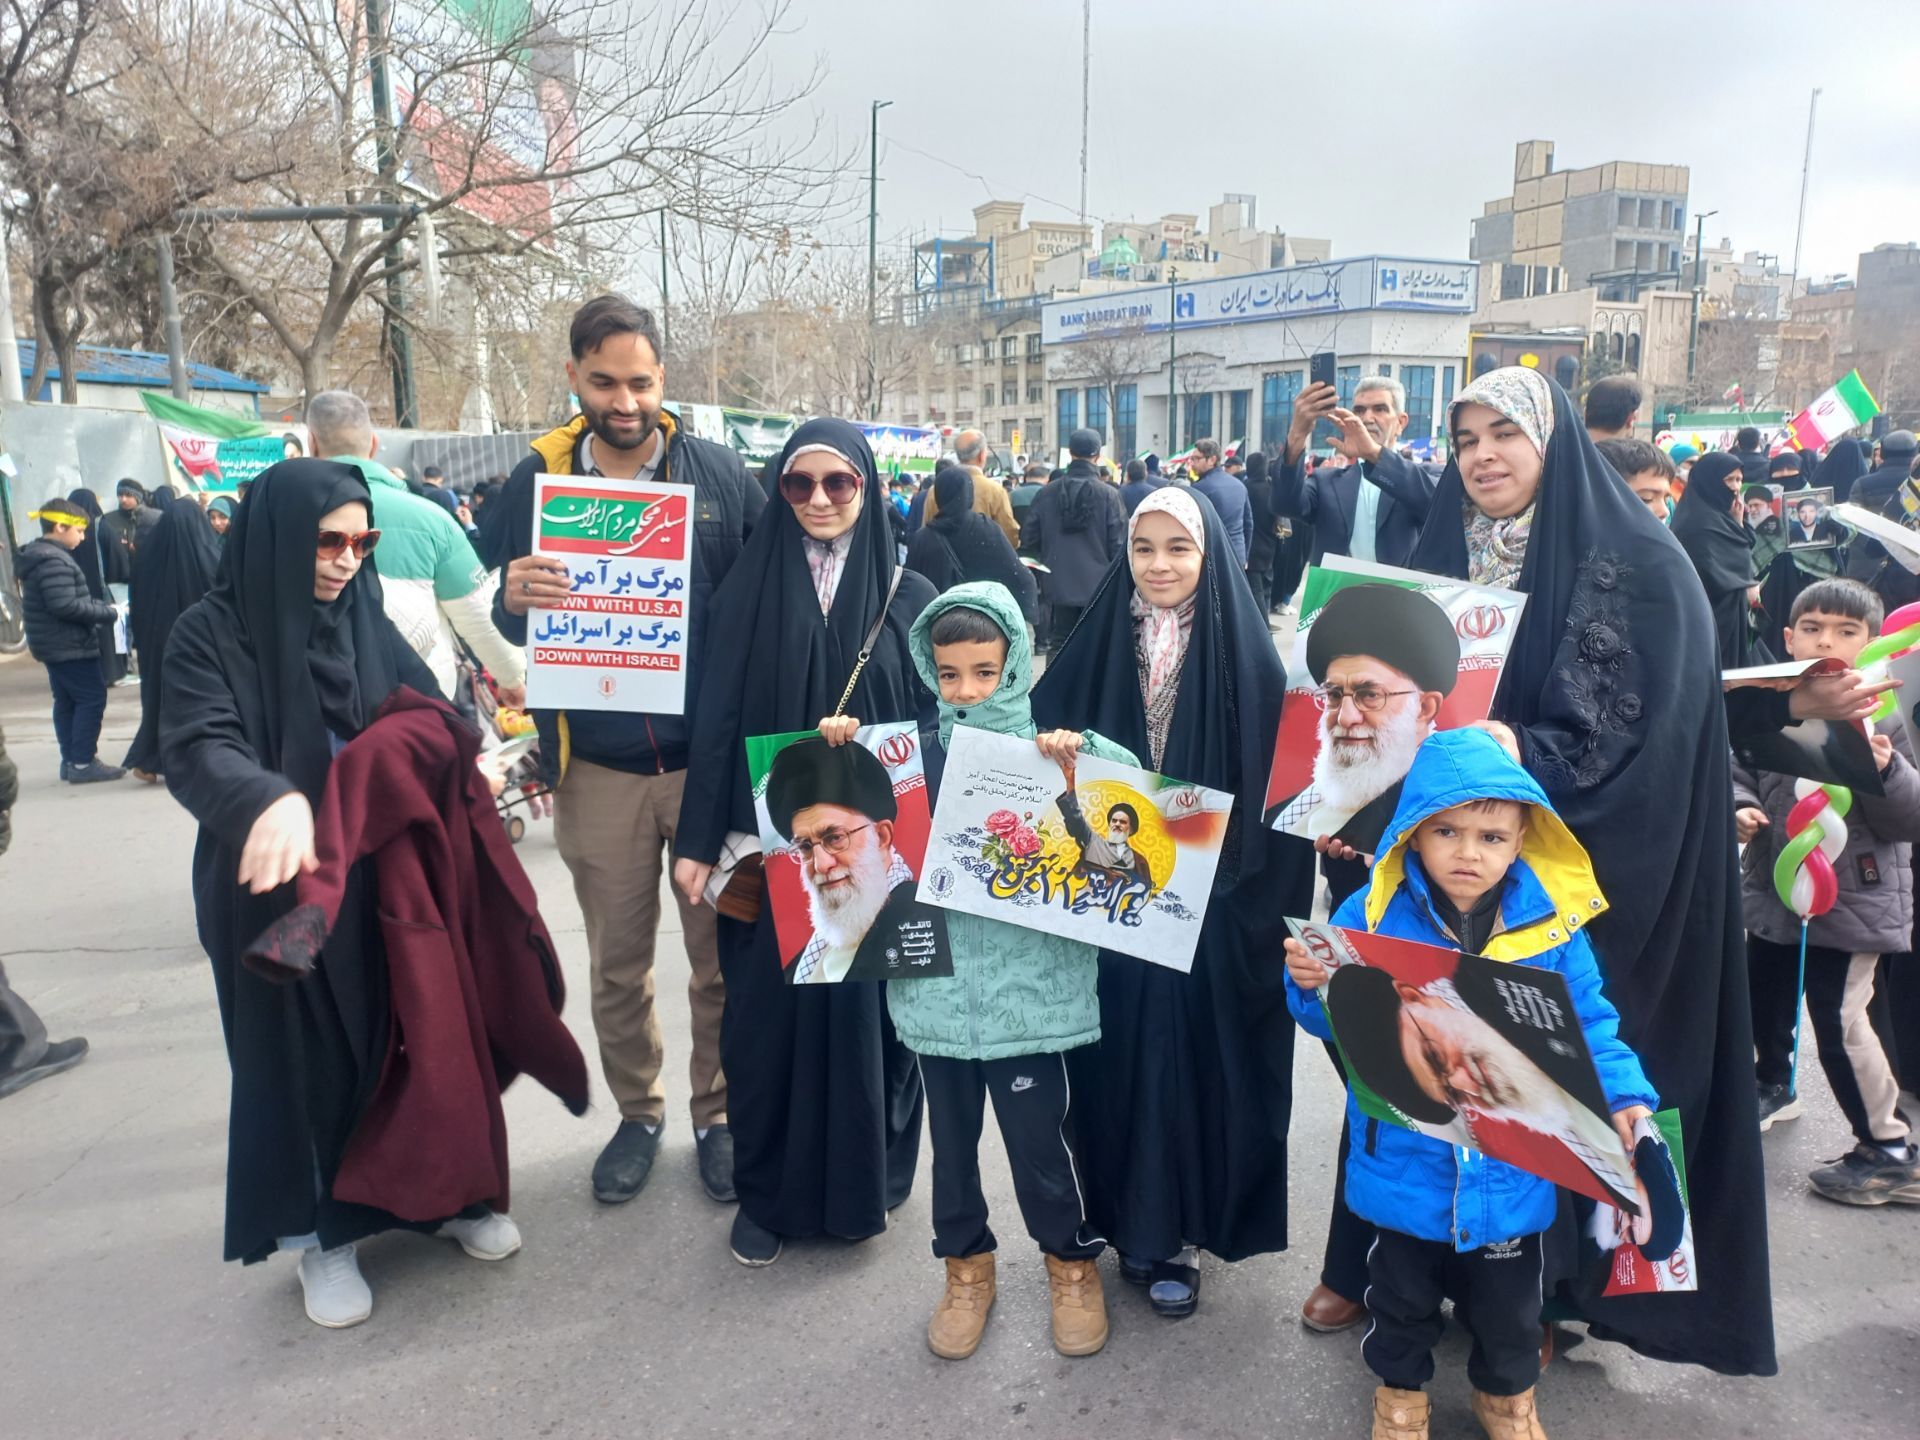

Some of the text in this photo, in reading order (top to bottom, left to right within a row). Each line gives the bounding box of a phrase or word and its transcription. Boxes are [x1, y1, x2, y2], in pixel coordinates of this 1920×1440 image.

[1402, 267, 1473, 292] بانک صادرات ایران
[1220, 265, 1345, 314] بانک صادرات ایران
[1060, 303, 1153, 327] BANK SADERAT IRAN
[541, 494, 686, 555] سیلی محکم مردم ایران
[609, 571, 633, 594] بر
[637, 566, 684, 598] مرگ
[592, 597, 634, 612] WITH
[638, 599, 680, 615] U.S.A
[534, 612, 682, 648] مرگ بر اسرائیل
[535, 650, 678, 669] DOWN WITH ISRAEL
[1017, 783, 1035, 793] بهمن
[1024, 794, 1042, 804] اسلام
[987, 850, 1060, 900] بهمن
[1042, 866, 1089, 910] ۲۲
[898, 920, 926, 932] انقلاب
[907, 931, 934, 940] مهدی
[901, 938, 935, 948] نهضت
[903, 946, 937, 956] ادامه
[1014, 1075, 1034, 1086] NIKE
[1484, 1250, 1523, 1260] adidas
